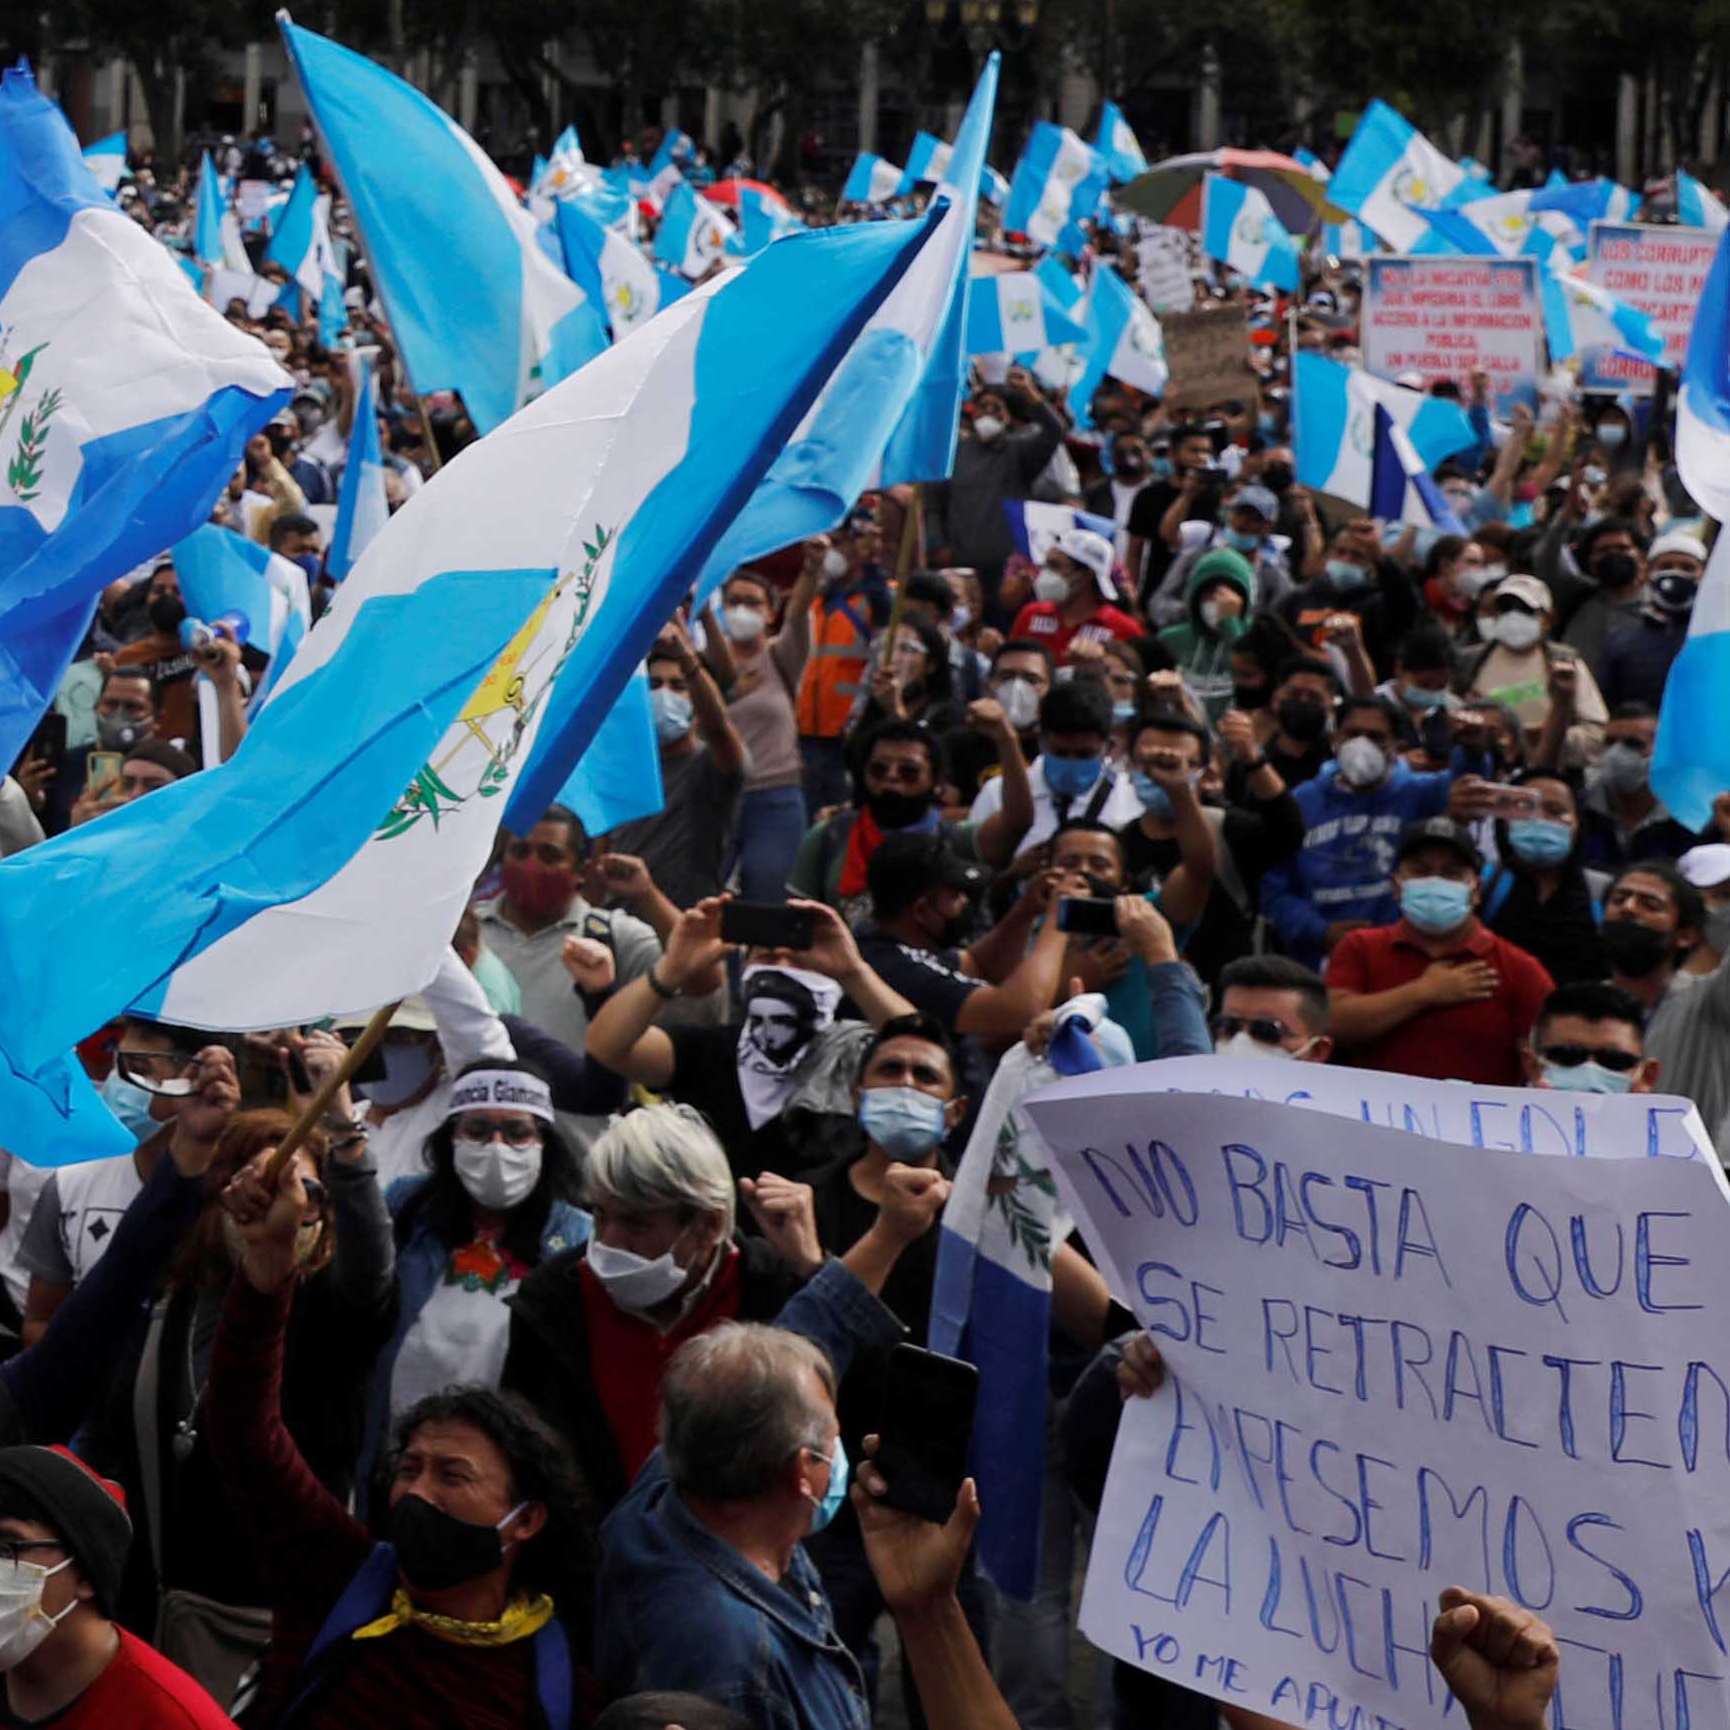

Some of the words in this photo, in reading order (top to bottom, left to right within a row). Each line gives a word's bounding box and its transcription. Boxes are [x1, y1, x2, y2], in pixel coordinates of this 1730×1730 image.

[1080, 1140, 1200, 1226] NO
[1222, 1143, 1452, 1288] BASTA
[1505, 1201, 1704, 1324] QUE
[1138, 1261, 1227, 1355] SE
[1124, 1494, 1231, 1614] LA
[1260, 1534, 1455, 1718] LUCH
[1130, 1623, 1180, 1665] YO
[1195, 1653, 1249, 1694] ME
